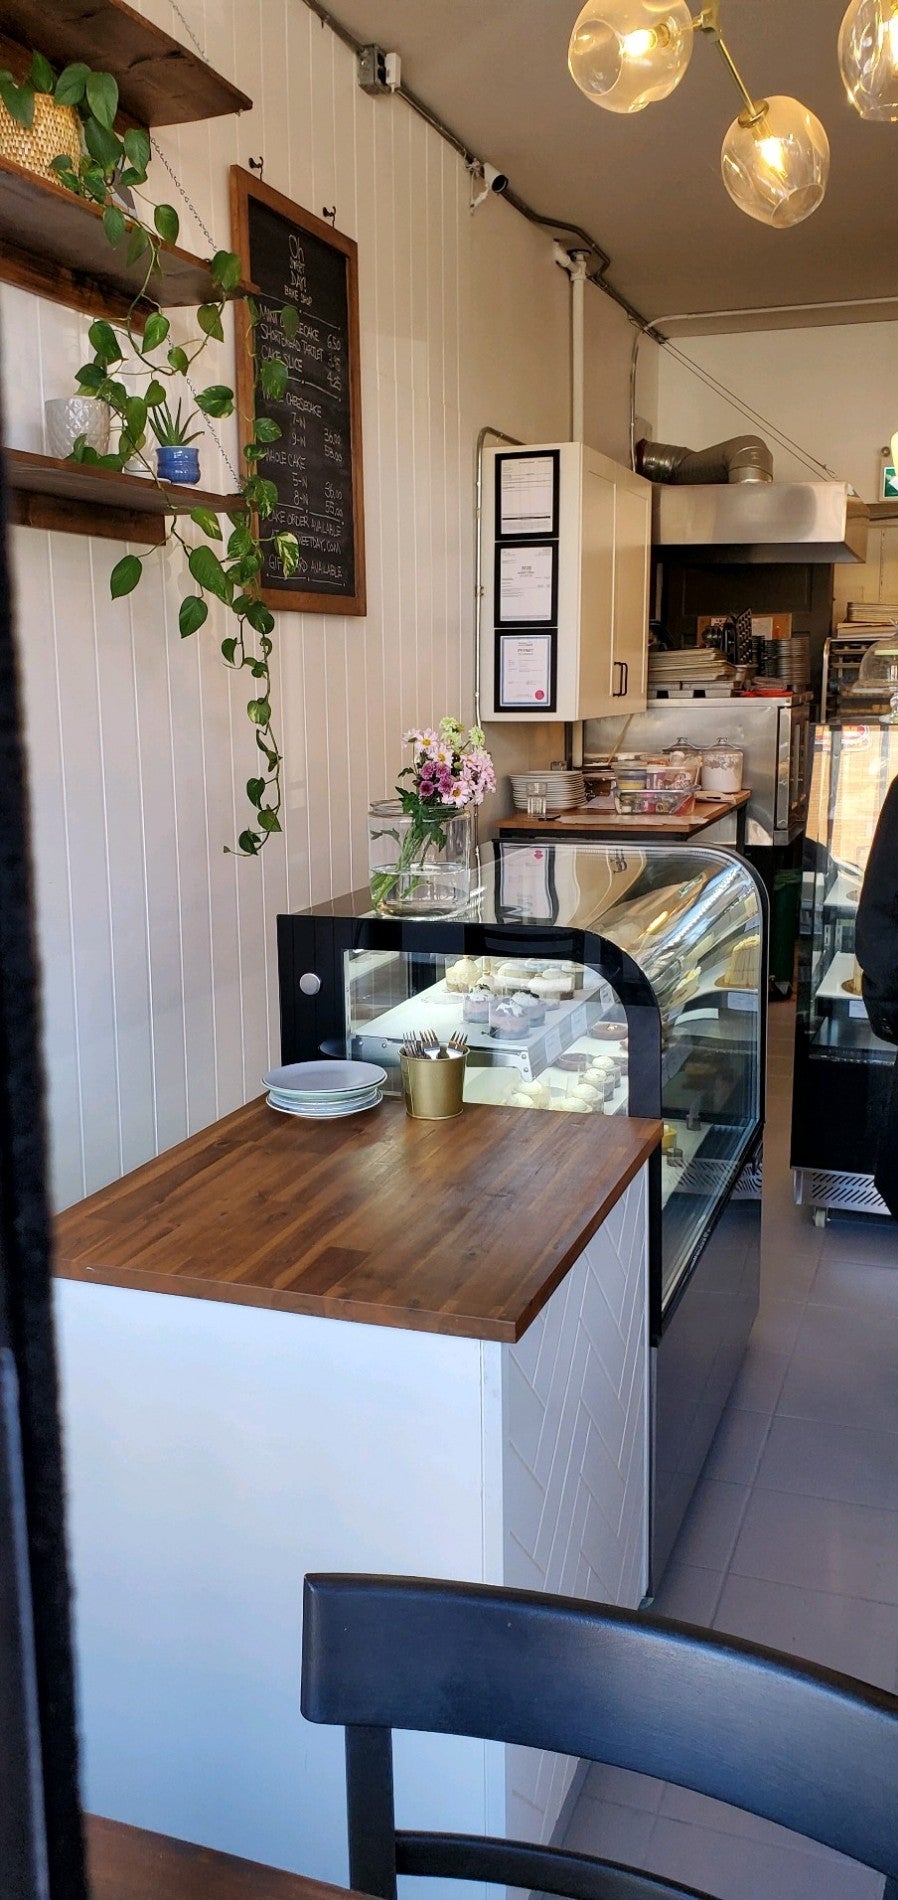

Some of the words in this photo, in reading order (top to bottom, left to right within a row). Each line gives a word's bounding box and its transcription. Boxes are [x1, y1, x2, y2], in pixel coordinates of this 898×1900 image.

[288, 233, 305, 263] Oh
[283, 353, 303, 373] SLICE
[287, 453, 307, 471] CAKE
[267, 510, 286, 524] CAKE
[287, 513, 310, 528] ORDER
[310, 518, 342, 538] AVAILABLE
[310, 560, 343, 579] AVAILABLE
